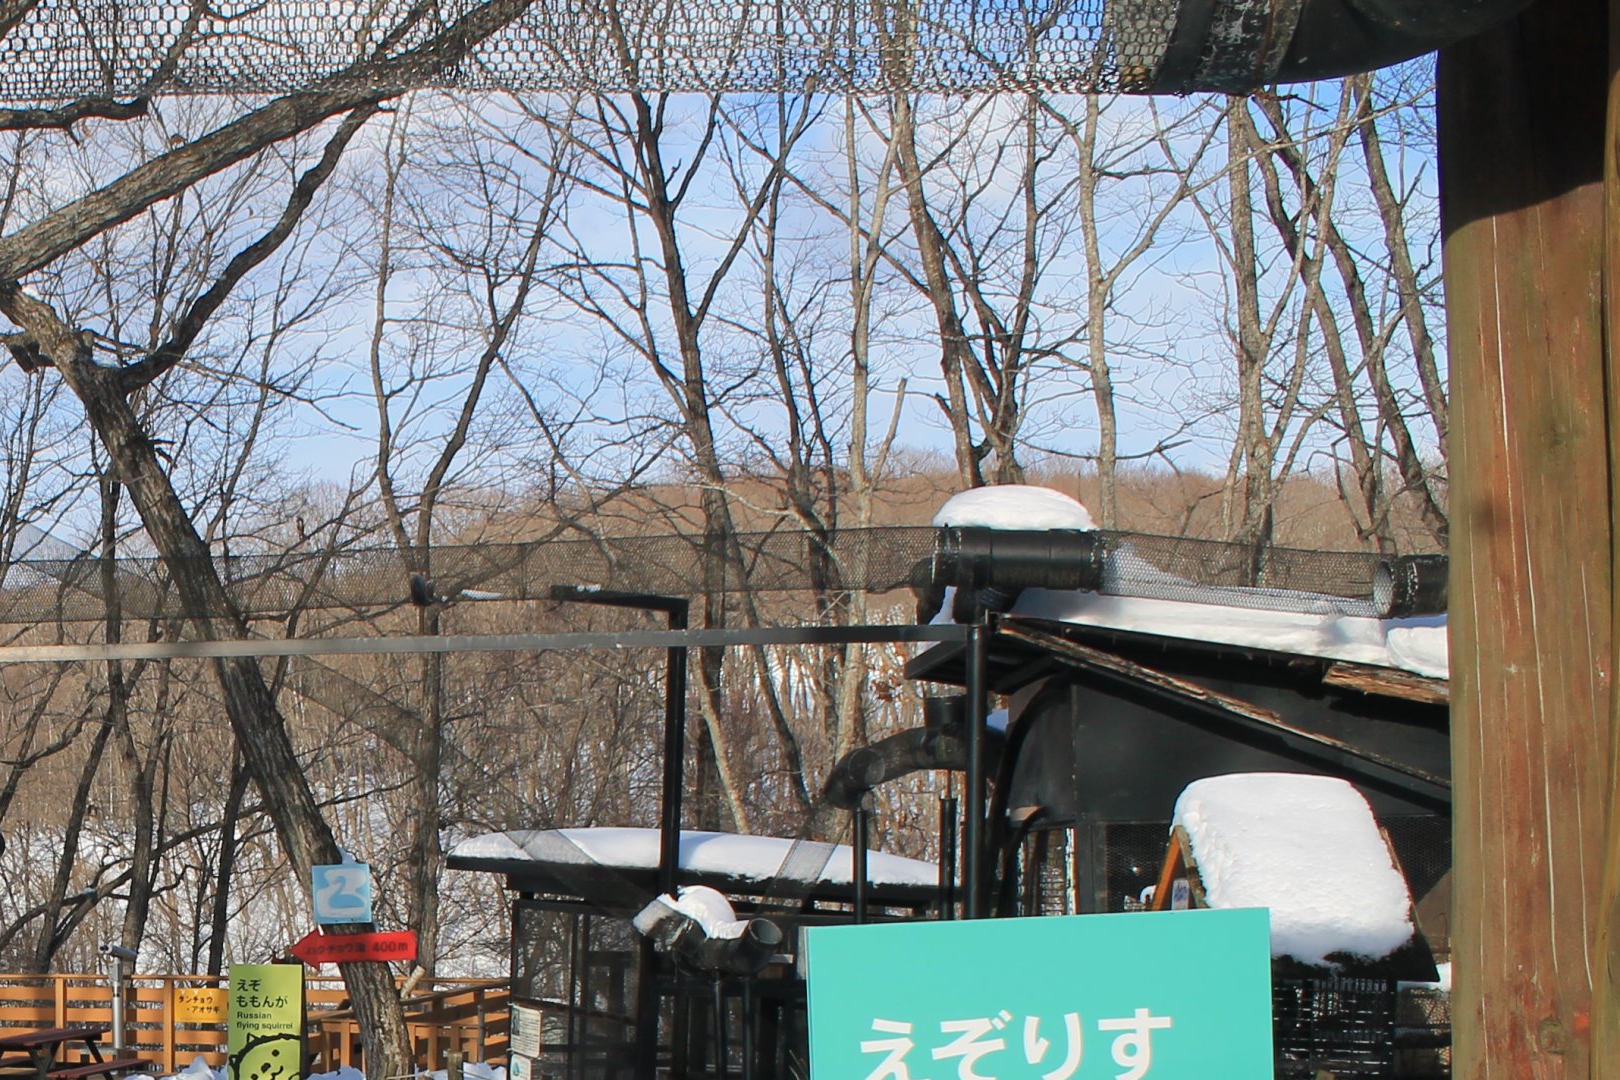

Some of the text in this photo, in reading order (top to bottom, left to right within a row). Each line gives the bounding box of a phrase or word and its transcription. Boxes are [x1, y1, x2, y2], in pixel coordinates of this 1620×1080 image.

[237, 979, 261, 991] えぞ
[236, 995, 288, 1008] ももんが
[237, 1011, 271, 1019] Russian
[237, 1021, 292, 1030] flying squirrel
